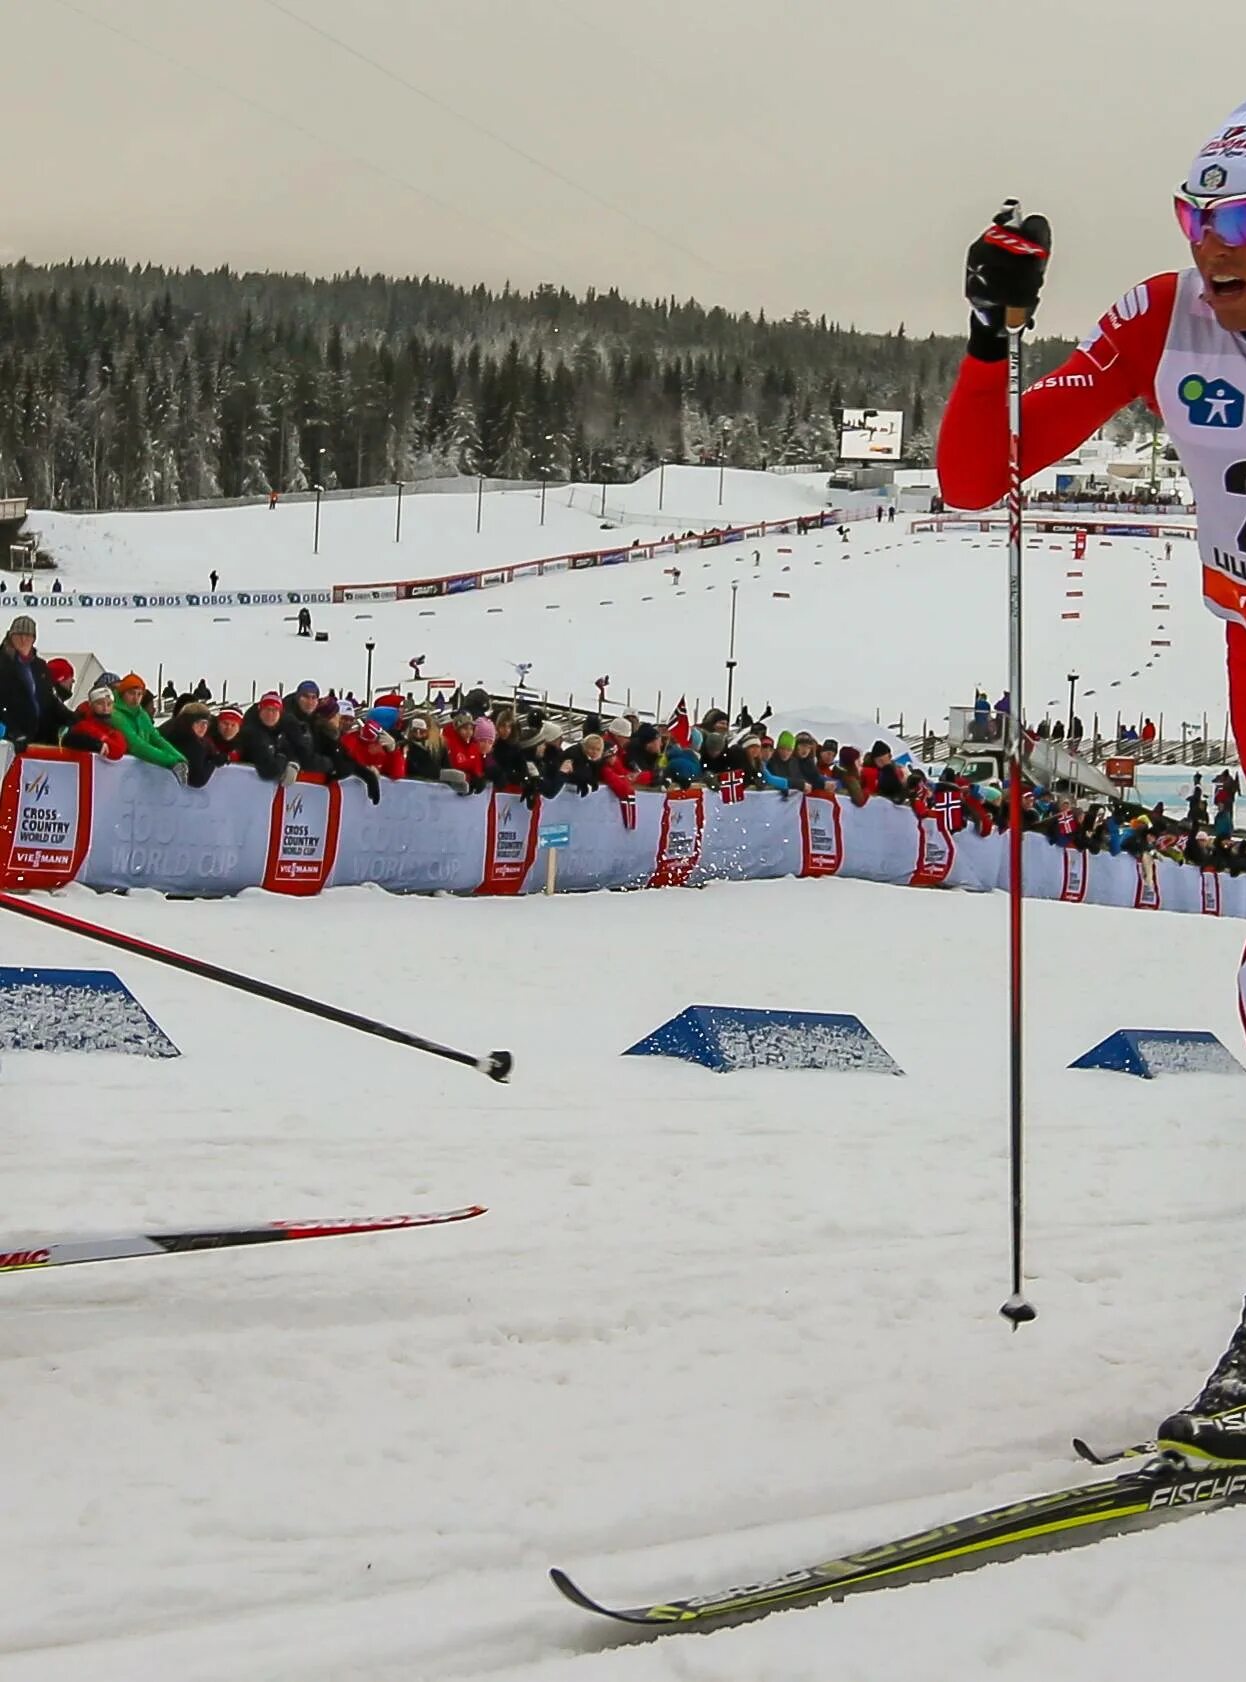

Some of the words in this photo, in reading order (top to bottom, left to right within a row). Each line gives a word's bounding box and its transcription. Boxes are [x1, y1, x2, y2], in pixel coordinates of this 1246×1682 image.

[40, 596, 74, 608] OBOS
[95, 596, 129, 607] OBOS
[149, 596, 182, 606] OBOS
[201, 595, 234, 606] OBOS
[252, 594, 283, 604] OBOS
[303, 592, 332, 603] OBOS
[21, 819, 70, 833] COUNTRY
[20, 831, 49, 843] WORLD
[50, 833, 66, 844] CUP
[283, 836, 320, 847] COUNTRY
[112, 846, 192, 877] WORLD
[198, 848, 239, 878] CUP
